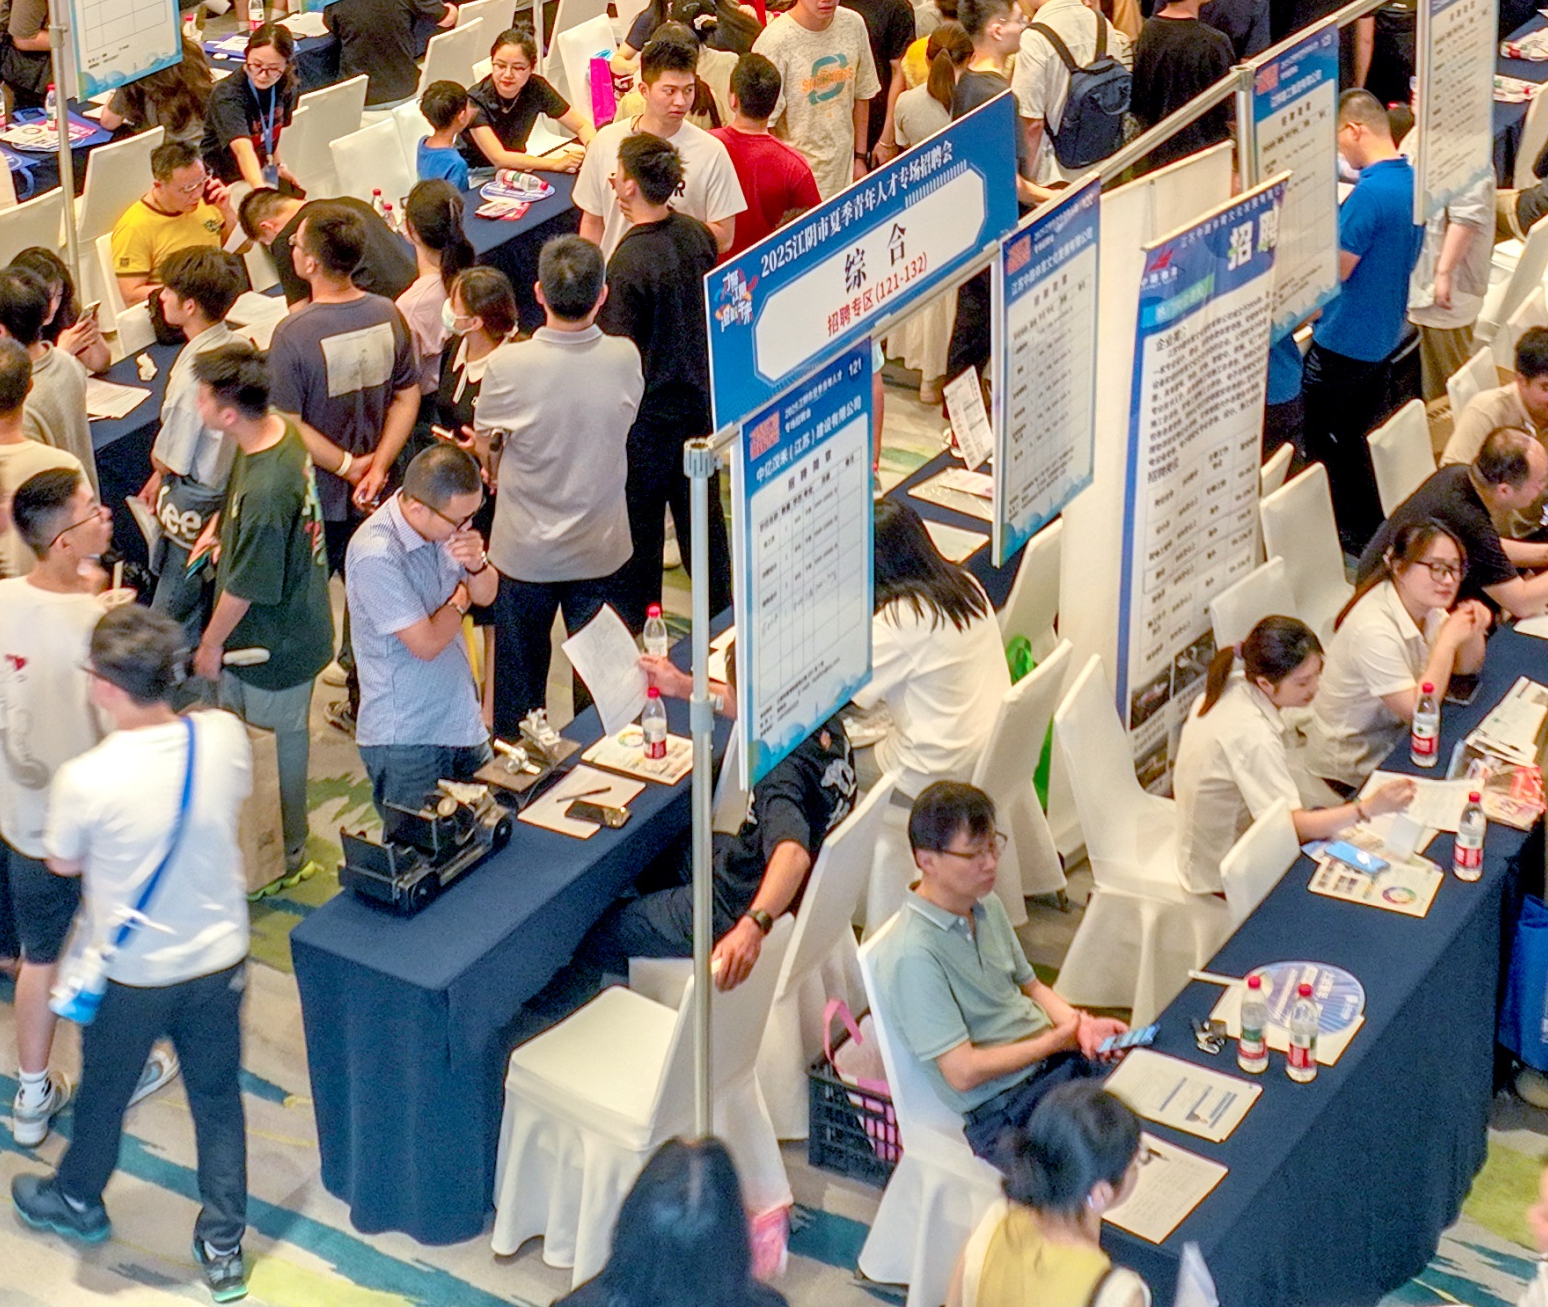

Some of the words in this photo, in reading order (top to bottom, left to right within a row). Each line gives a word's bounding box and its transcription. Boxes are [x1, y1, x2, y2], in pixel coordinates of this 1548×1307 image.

[761, 140, 954, 279] 2025江阴市夏季青年人才专场招聘会
[1227, 205, 1279, 272] 招聘
[845, 223, 907, 294] 综合
[848, 356, 862, 378] 121
[156, 485, 202, 540] Lee
